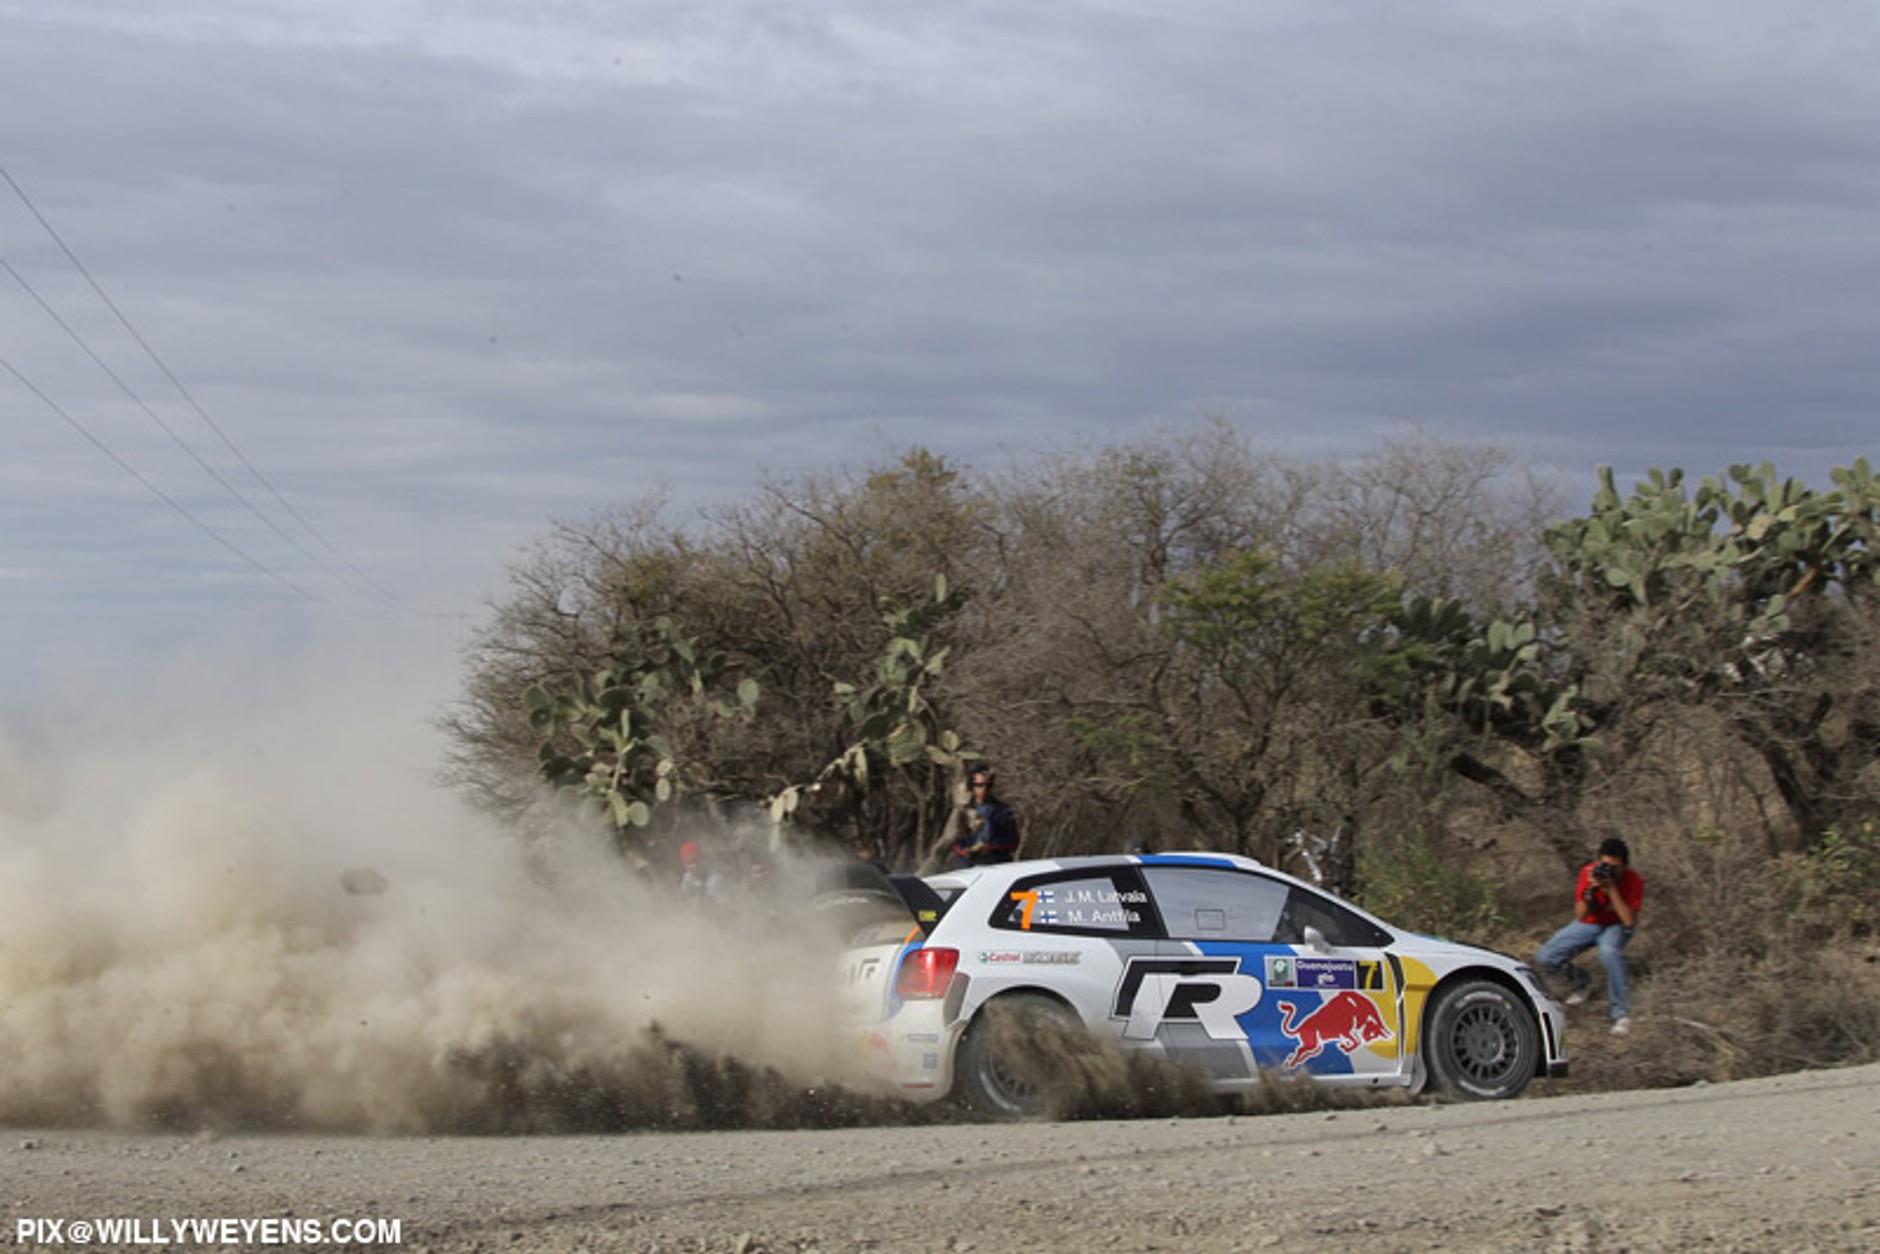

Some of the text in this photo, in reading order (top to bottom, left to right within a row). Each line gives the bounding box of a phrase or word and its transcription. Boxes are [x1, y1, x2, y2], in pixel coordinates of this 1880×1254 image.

[1010, 891, 1039, 931] 7
[1067, 910, 1088, 923] M.
[1359, 960, 1378, 989] 7
[1117, 970, 1263, 1040] R
